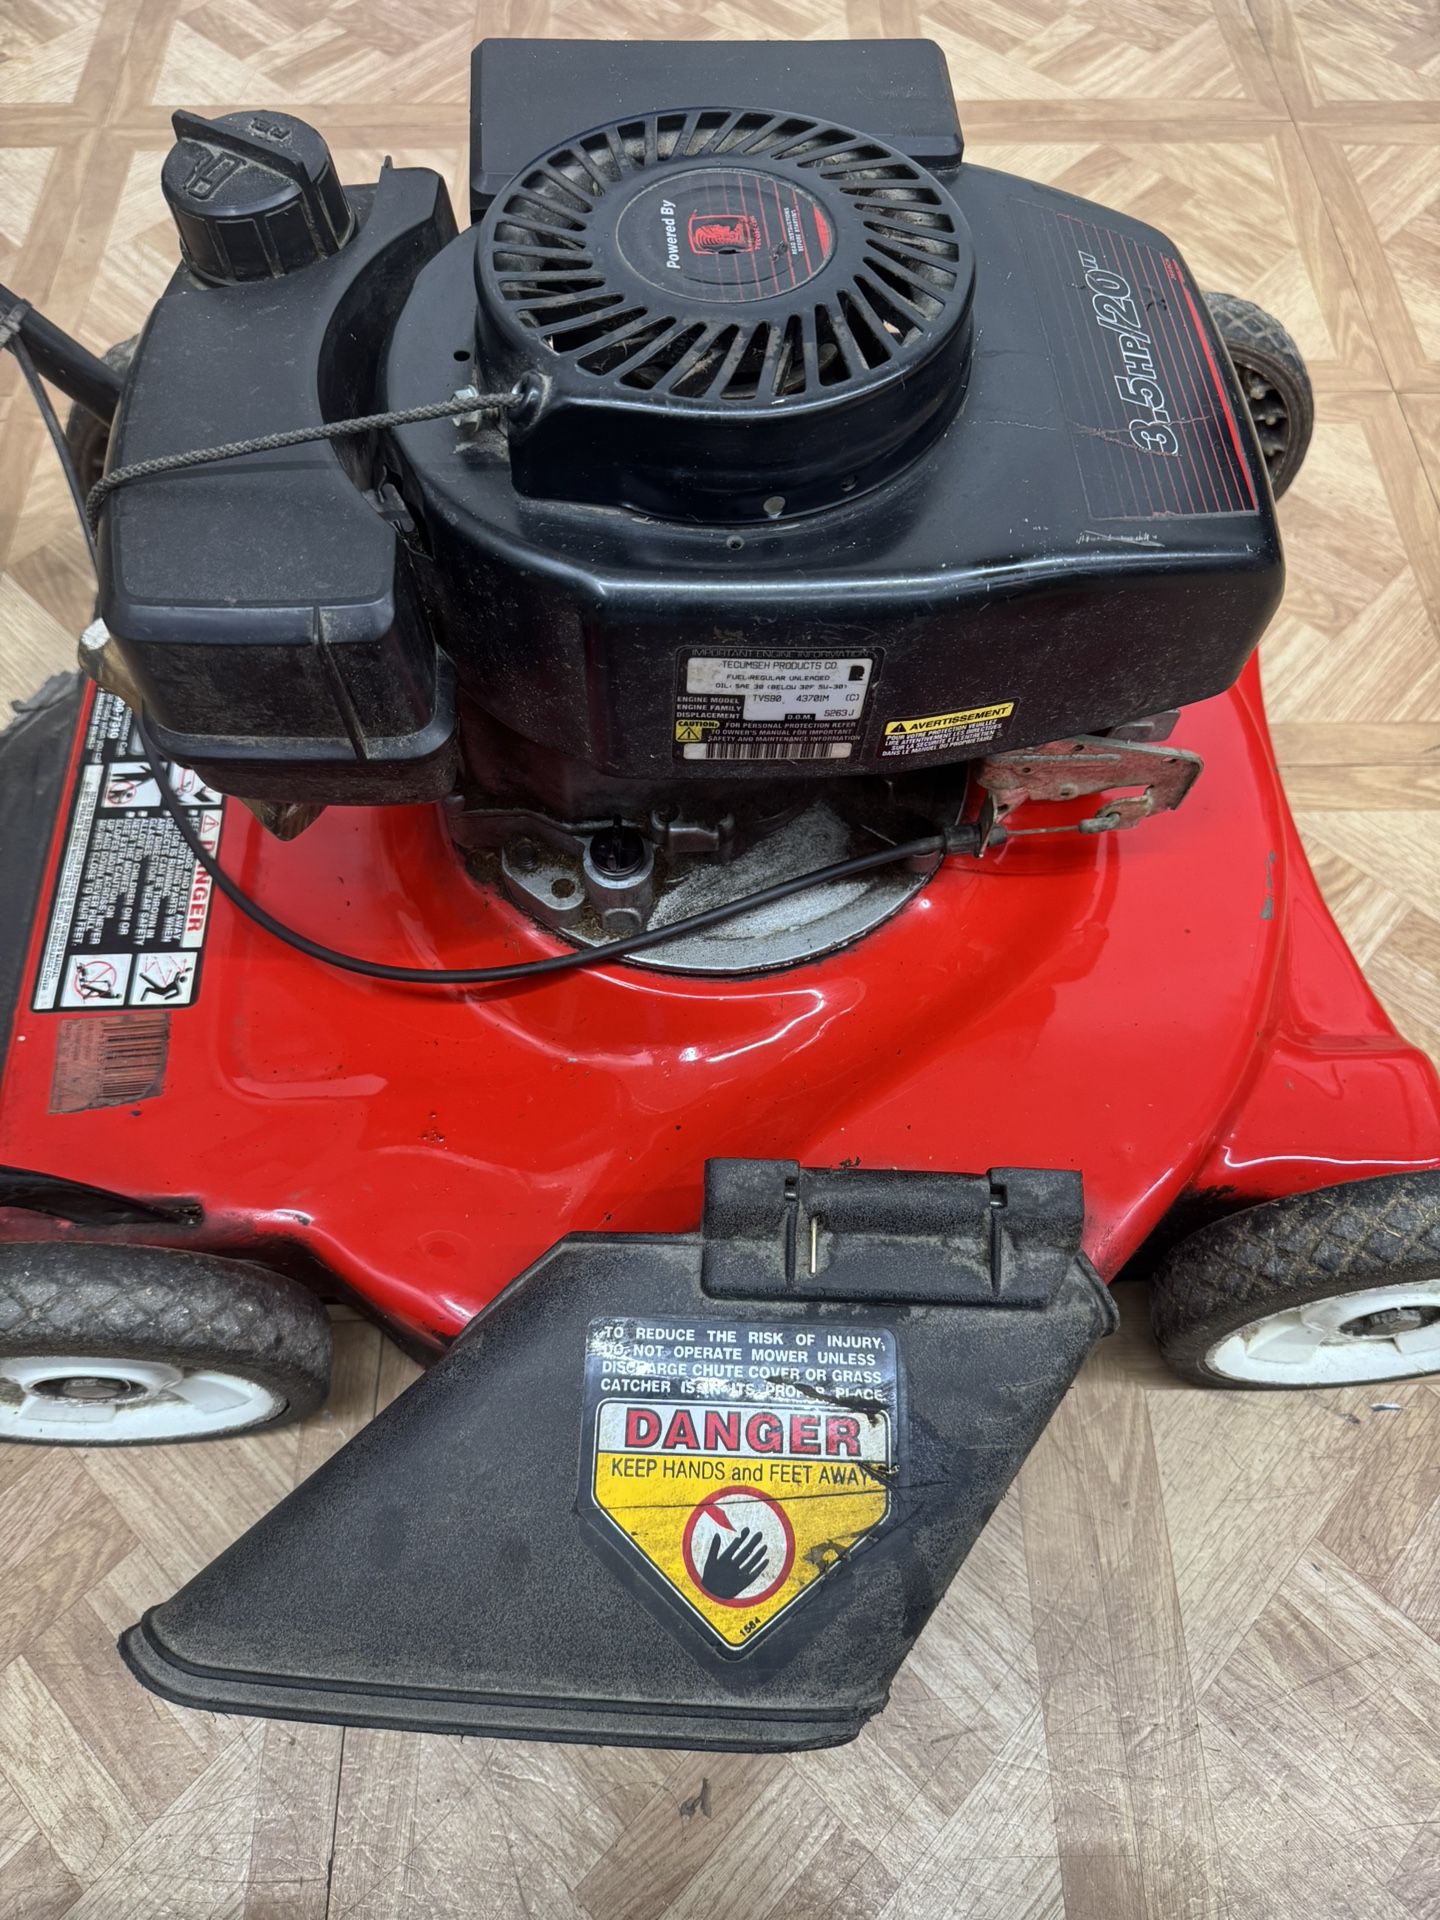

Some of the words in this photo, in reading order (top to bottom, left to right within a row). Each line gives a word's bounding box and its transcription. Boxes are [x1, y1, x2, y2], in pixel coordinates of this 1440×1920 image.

[660, 199, 677, 216] By
[661, 218, 681, 270] Powered
[691, 649, 752, 658] IMPORTANT
[756, 649, 793, 659] ENGINE
[797, 650, 870, 659] INFORMATION
[721, 660, 771, 670] TECUMSEH
[773, 660, 822, 671] PRODUCTS
[710, 704, 742, 712] FAMILY
[711, 697, 740, 705] MODEL
[676, 711, 740, 719] DISPLACEMENT
[832, 721, 857, 729] REFER
[909, 706, 1008, 731] AVERTISSEMENT
[927, 724, 967, 737] PROTECTION
[92, 819, 106, 850] MOWER
[110, 819, 124, 851] SLOPES
[122, 819, 133, 835] USE
[130, 819, 141, 841] NEAR
[138, 818, 149, 848] ALLOW
[155, 818, 165, 834] ANY
[161, 817, 175, 855] OBJECTS
[102, 832, 113, 850] AND
[117, 836, 129, 865] EXTRA
[126, 843, 137, 860] THE
[134, 849, 144, 861] NO
[158, 856, 168, 875] CAN
[173, 842, 188, 884] ROTATING
[86, 851, 100, 881] CLOSE
[82, 882, 94, 895] TO
[109, 866, 124, 903] CAUTION
[124, 862, 141, 906] CHILDREN
[155, 876, 165, 888] BE
[181, 871, 191, 888] AND
[187, 840, 216, 932] DNGER
[78, 896, 91, 920] YOUR
[143, 884, 155, 911] WEAR
[168, 886, 180, 914] PARTS
[177, 891, 188, 912] FEET
[105, 904, 116, 918] ON
[121, 907, 133, 921] ON
[148, 890, 162, 927] THROWN
[86, 909, 98, 931] PULL
[90, 914, 104, 945] NEVER
[118, 921, 130, 935] OR
[134, 912, 150, 946] SAFETY
[162, 915, 176, 942] WHEN
[173, 914, 185, 939] AWAY
[71, 921, 86, 947] FEET.
[146, 929, 156, 939] IN
[604, 1327, 624, 1339] TO
[636, 1328, 695, 1341] REDUCE
[707, 1330, 737, 1343] THE
[748, 1331, 784, 1345] RISK
[796, 1334, 816, 1346] OF
[633, 1345, 668, 1357] NOT
[673, 1346, 743, 1360] OPERATE
[751, 1349, 808, 1363] MOWER
[817, 1351, 876, 1366] UNLESS
[692, 1364, 744, 1378] CHUTE
[748, 1366, 800, 1381] COVER
[805, 1368, 827, 1382] OR
[832, 1370, 882, 1384] GRASS
[601, 1378, 671, 1393] CATCHER
[681, 1381, 695, 1394] IS
[766, 1384, 826, 1399] PROPR
[624, 1407, 862, 1457] DANGER
[611, 1458, 658, 1478] KEEP
[662, 1461, 726, 1480] HANDS
[732, 1463, 763, 1481] and
[769, 1464, 813, 1484] FEET
